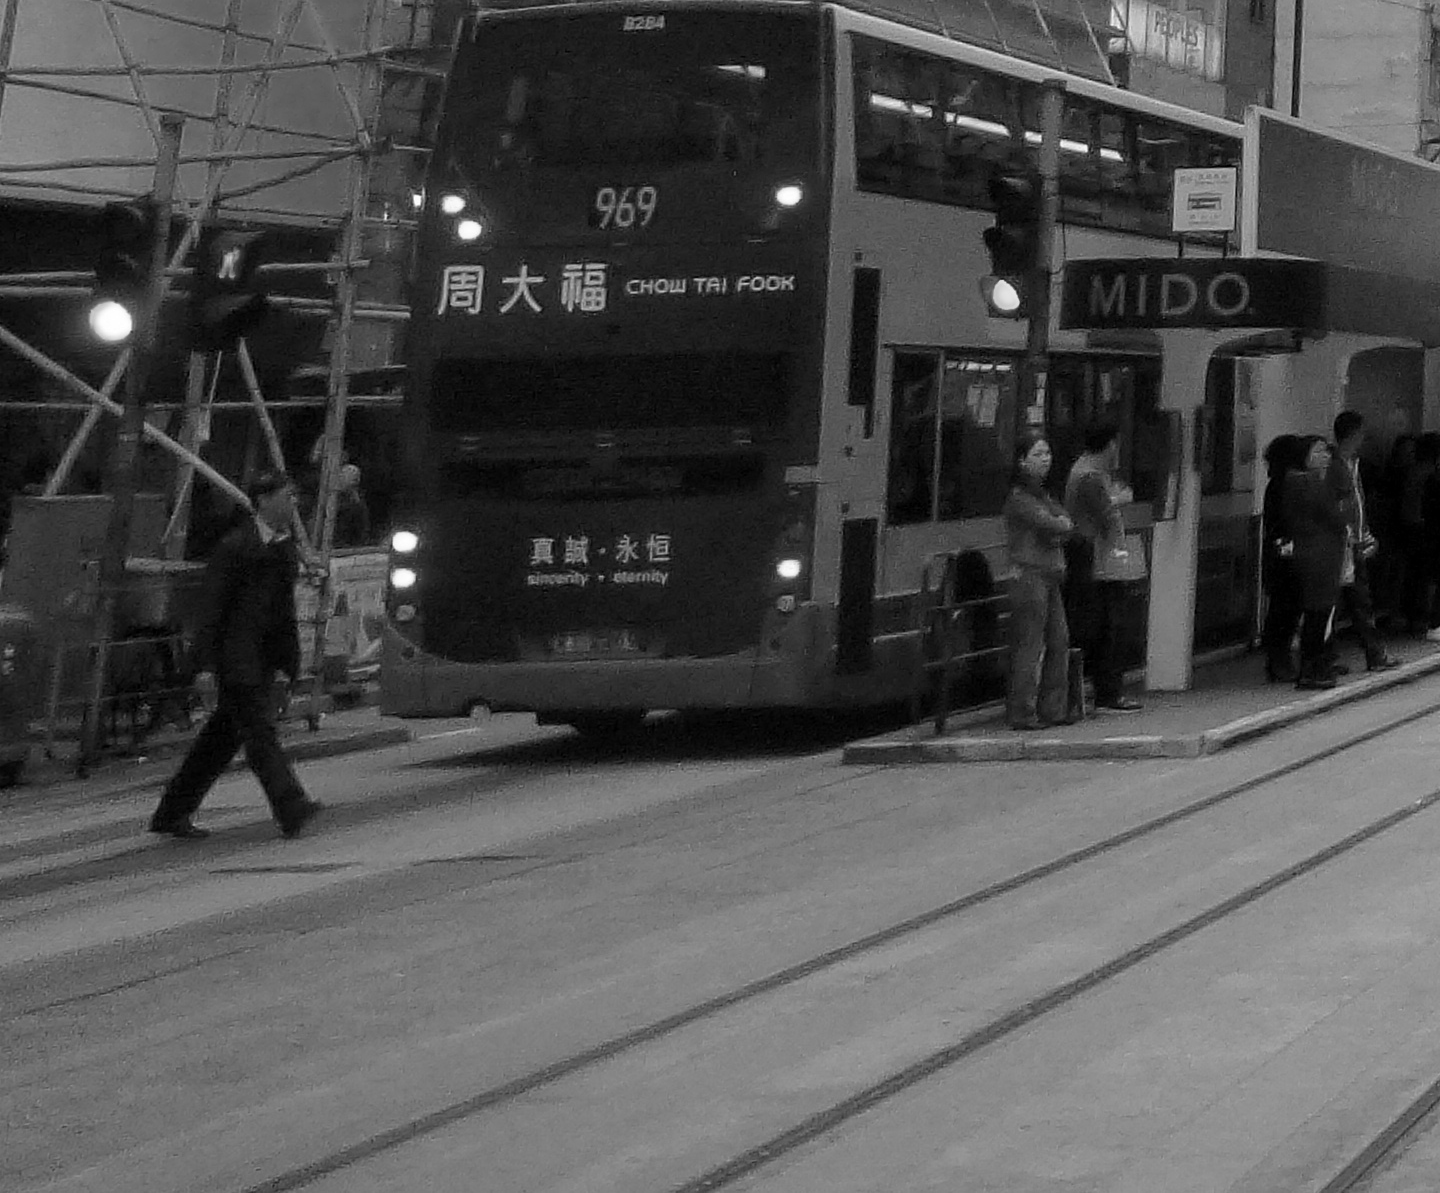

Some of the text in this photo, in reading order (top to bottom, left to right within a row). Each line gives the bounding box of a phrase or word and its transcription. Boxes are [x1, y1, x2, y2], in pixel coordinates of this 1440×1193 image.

[596, 186, 657, 229] 969
[437, 262, 609, 315] 周大福
[624, 275, 796, 295] CHOW TAI FOOK
[1089, 273, 1250, 317] MIDO
[527, 569, 669, 587] sincerity eternity
